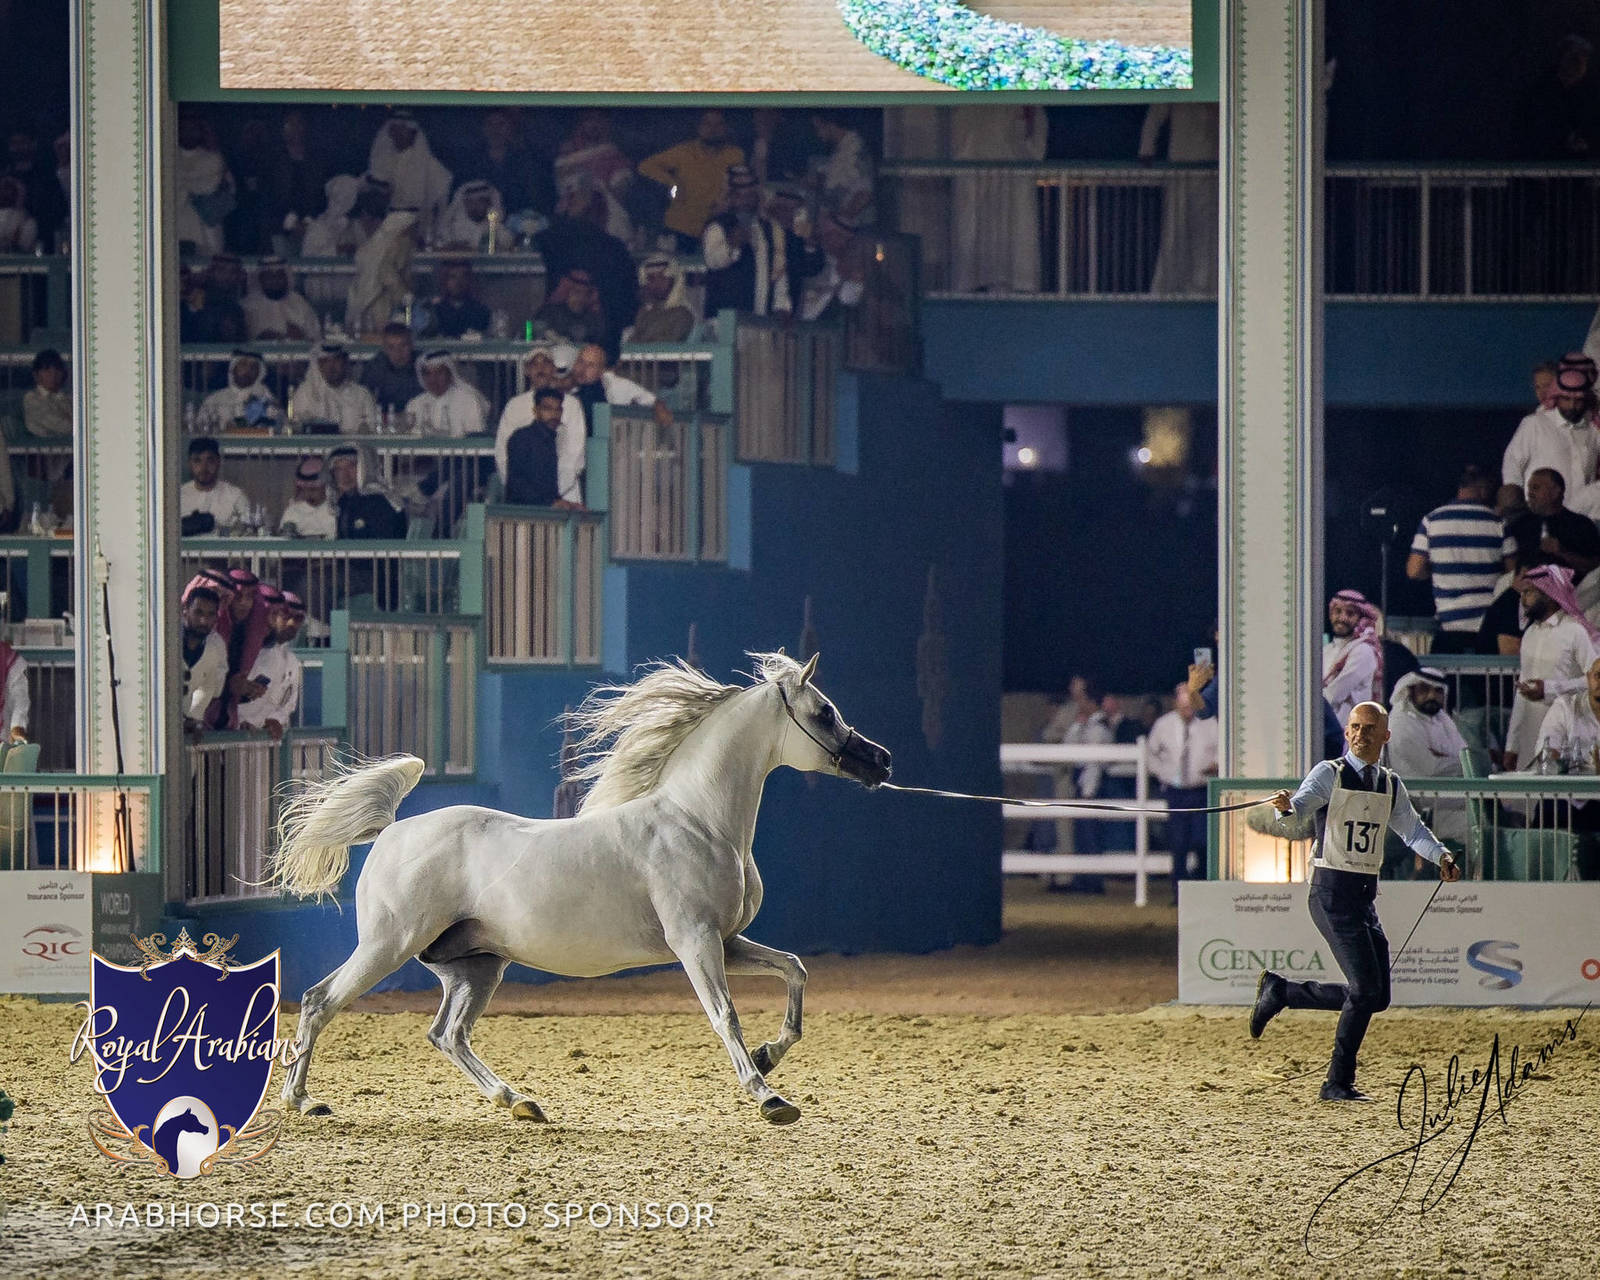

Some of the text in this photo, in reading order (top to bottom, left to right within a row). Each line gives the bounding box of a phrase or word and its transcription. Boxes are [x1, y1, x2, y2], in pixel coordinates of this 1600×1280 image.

[1343, 820, 1380, 854] 137
[59, 892, 85, 901] Sponsor
[100, 892, 130, 915] WORLD
[1235, 904, 1290, 913] Strategic Partner
[1456, 905, 1483, 914] Sponsor
[22, 941, 84, 962] QIC
[1209, 949, 1326, 971] CENECA
[1397, 977, 1426, 985] Delivery
[1434, 977, 1459, 985] Legacy
